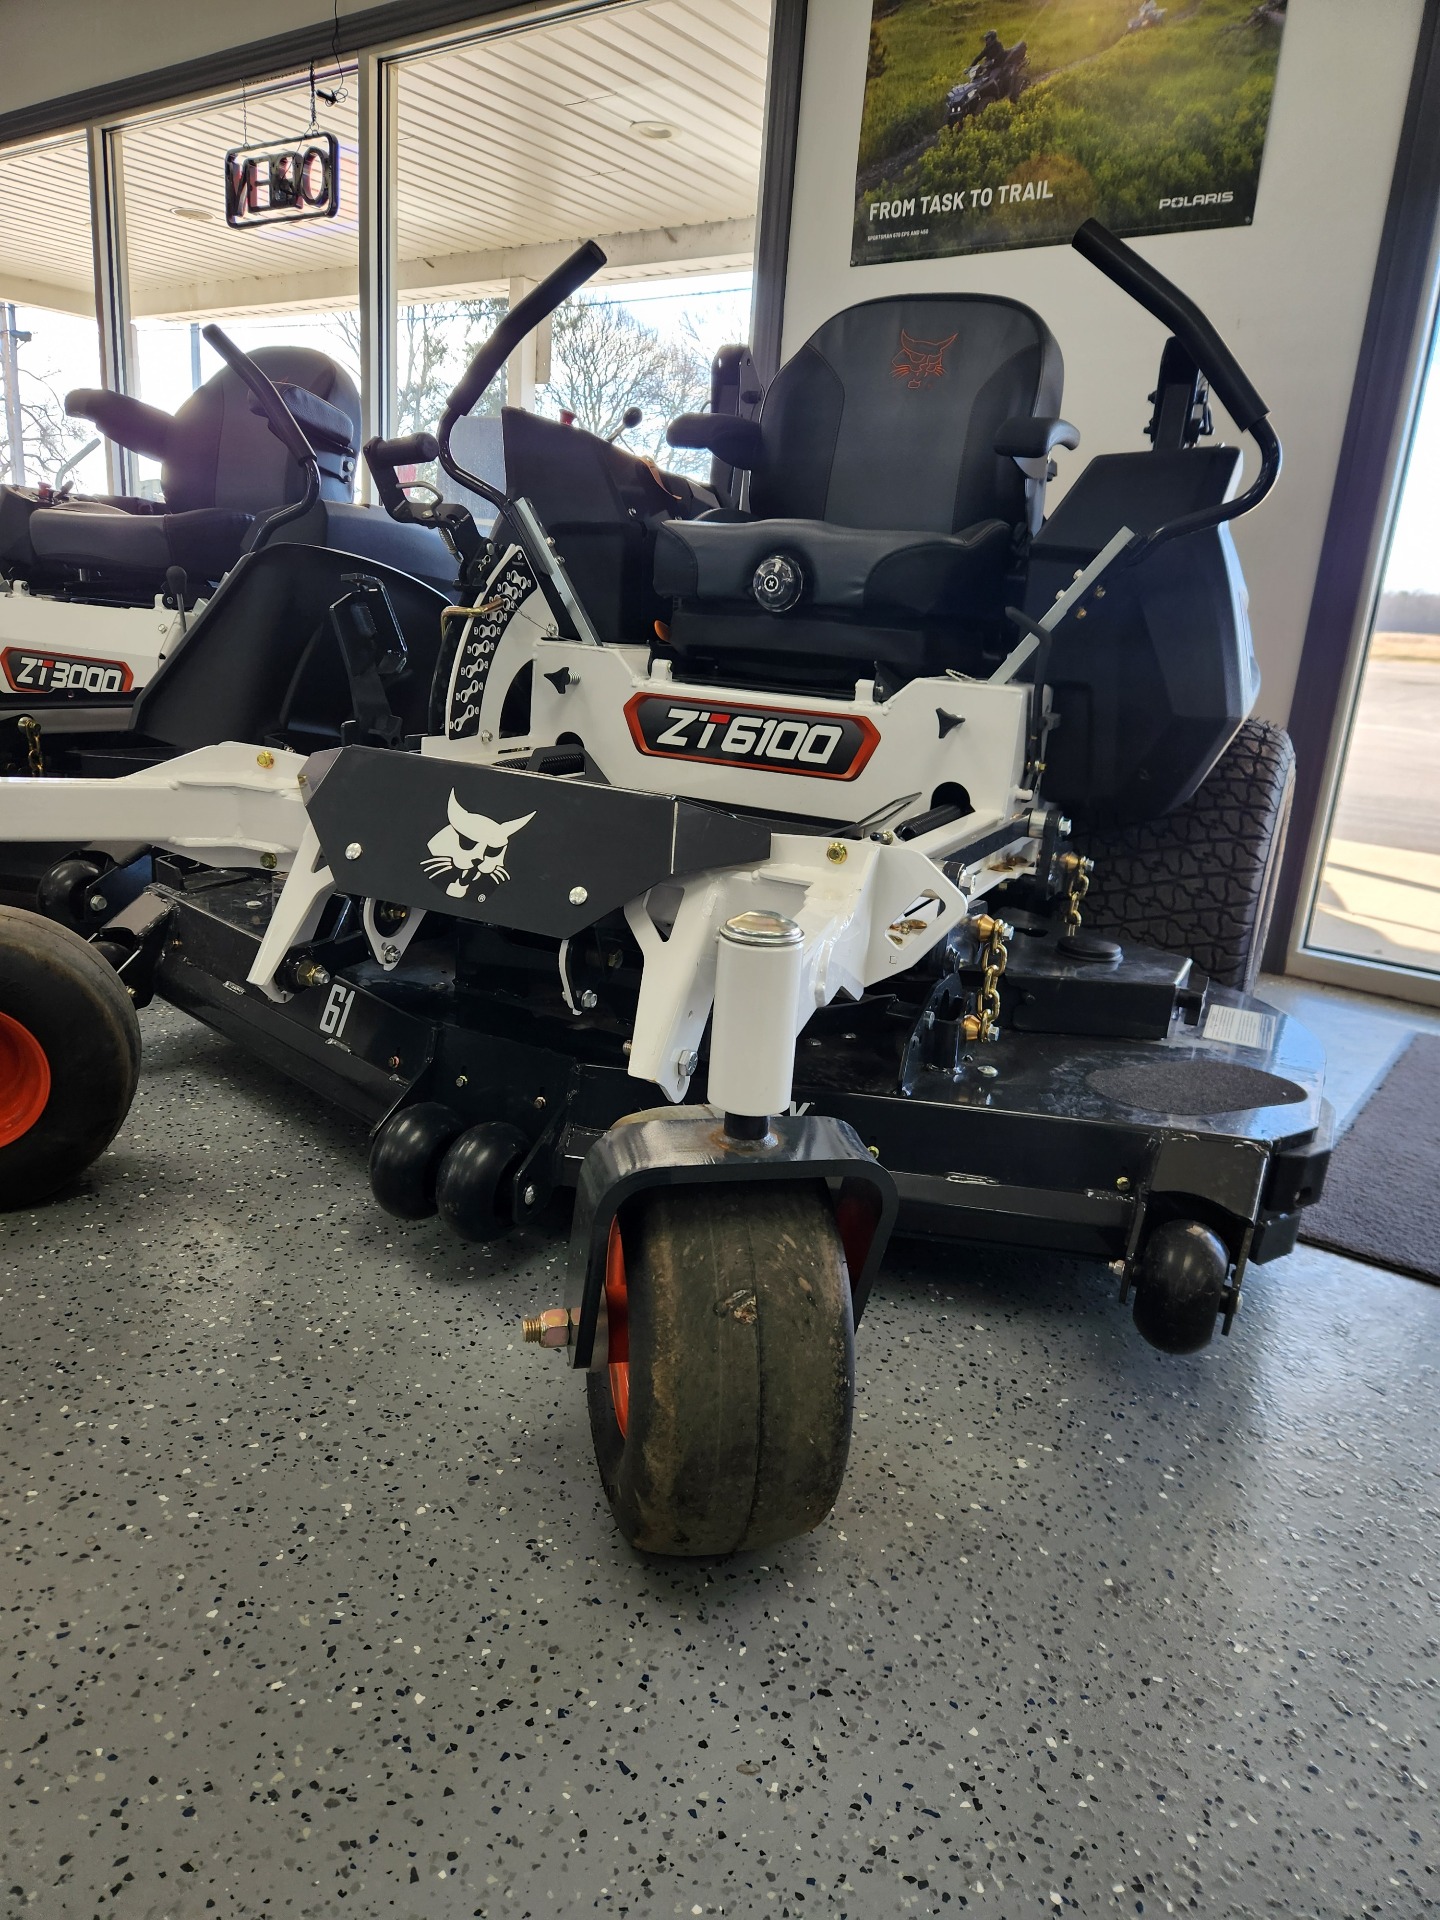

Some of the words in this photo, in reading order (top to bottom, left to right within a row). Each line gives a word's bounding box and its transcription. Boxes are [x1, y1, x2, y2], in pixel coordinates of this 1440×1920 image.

[869, 198, 916, 221] FROM
[920, 191, 965, 215] TASK
[970, 187, 993, 208] TO
[998, 180, 1054, 204] TRAIL
[1159, 191, 1234, 210] POLARIS
[656, 708, 844, 764] ZT6100
[319, 983, 356, 1038] 61
